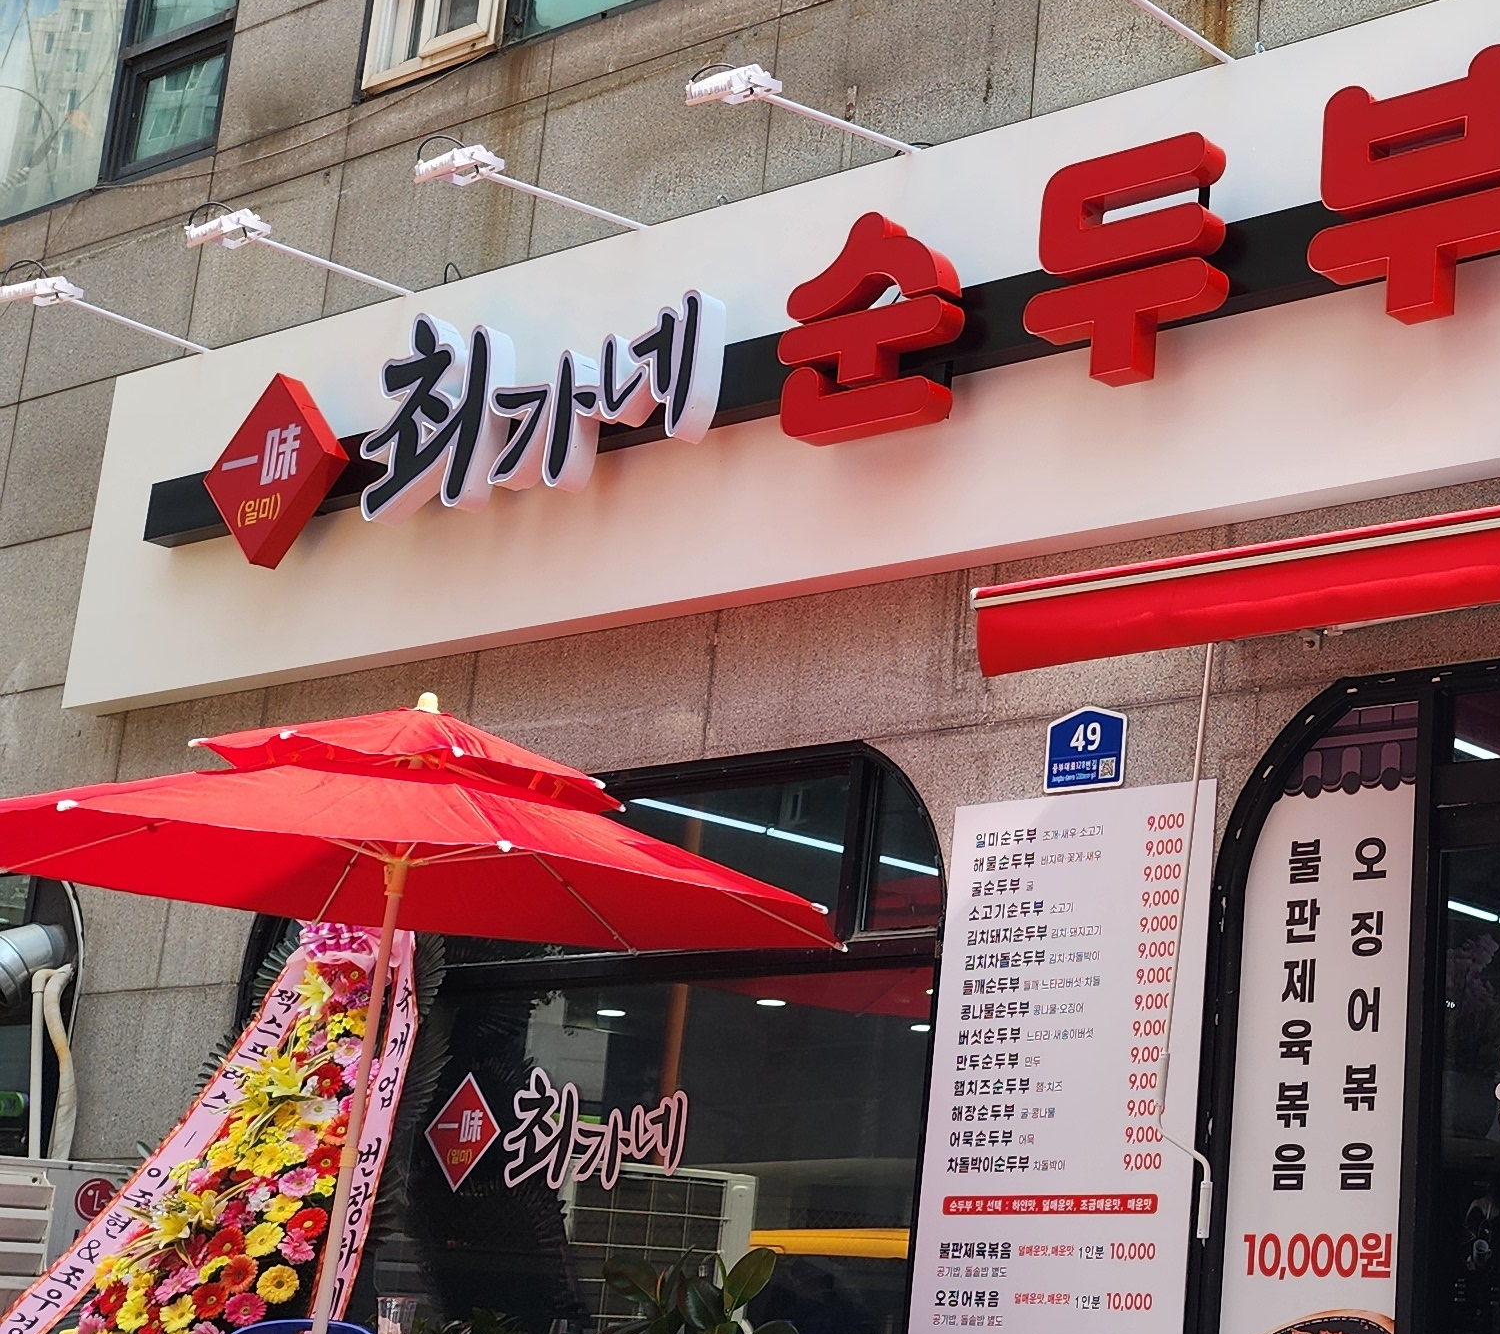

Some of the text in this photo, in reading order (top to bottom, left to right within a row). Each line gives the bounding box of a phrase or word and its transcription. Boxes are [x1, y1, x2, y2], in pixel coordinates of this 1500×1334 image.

[361, 290, 712, 522] 최가네
[221, 424, 301, 486] 一味
[236, 492, 281, 528] (일미)
[1069, 722, 1102, 752] 49
[975, 828, 1037, 848] 일미순두부
[1147, 813, 1184, 831] 9,000
[973, 852, 1035, 872] 해물순두부
[1145, 838, 1183, 856] 9,000
[971, 878, 1020, 897] 굴순두부
[1143, 863, 1181, 882] 9,000
[968, 900, 1044, 921] 소고기순두부
[1141, 889, 1179, 907] 9,000
[967, 925, 1047, 946] 김치돼지순두부
[1139, 915, 1177, 933] 9,000
[964, 949, 1045, 971] 김치차돌순두부
[1138, 940, 1175, 959] 9,000
[962, 976, 1020, 995] 들깨순두부
[960, 1001, 1030, 1020] 콩나물순두부
[1272, 839, 1321, 1191] 불판제육볶음
[1339, 836, 1387, 1191] 오징어볶음
[958, 1027, 1021, 1045] 버섯순두부
[956, 1053, 1019, 1071] 만두순두부
[954, 1078, 1030, 1096] 햄치즈순두부
[437, 1109, 483, 1142] 一味
[951, 1104, 1015, 1122] 해장순두부
[503, 1067, 688, 1191] 최가네
[949, 1130, 1013, 1147] 어묵순두부
[446, 1148, 472, 1165] (일미)
[946, 1155, 1030, 1173] 차돌박이순두부
[1123, 1153, 1161, 1172] 9,000
[949, 1199, 973, 1212] 순두부
[975, 1199, 984, 1212] 맛
[987, 1199, 1002, 1212] 선택
[1042, 1199, 1077, 1213] 덜매운맛,
[1079, 1199, 1124, 1213] 조금매운맛,
[1127, 1199, 1152, 1211] 매운맛
[77, 1239, 100, 1264] &
[939, 1242, 1012, 1260] 불판제육볶음
[1078, 1245, 1104, 1260] 1인분
[1109, 1242, 1156, 1261] 10,000
[1243, 1233, 1392, 1279] 10,000원
[937, 1266, 962, 1278] 공기밥,
[991, 1267, 1007, 1278] 별도
[934, 1290, 1000, 1308] 오징어볶음
[1074, 1295, 1101, 1310] 1인분
[1106, 1292, 1153, 1311] 10,000
[932, 1314, 958, 1327] 공기밥,
[987, 1316, 1003, 1327] 별도
